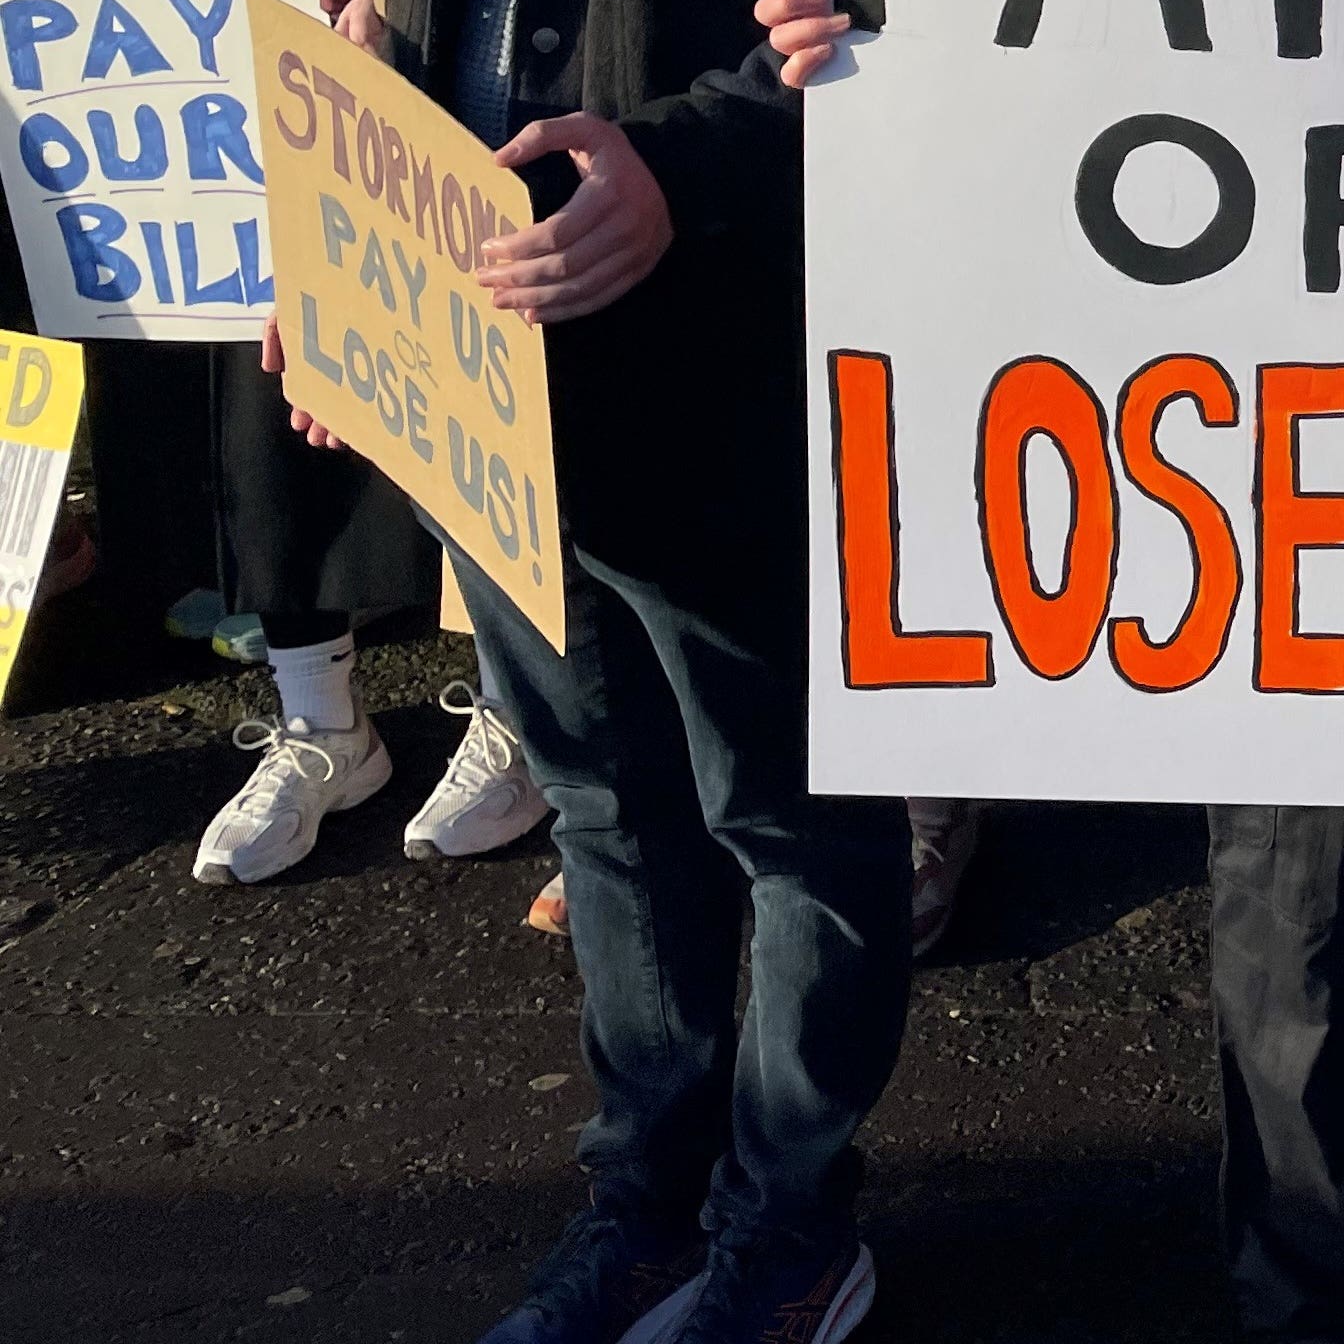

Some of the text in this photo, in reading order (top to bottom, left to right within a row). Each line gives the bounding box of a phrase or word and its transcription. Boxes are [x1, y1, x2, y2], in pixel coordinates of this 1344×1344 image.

[19, 93, 265, 192] OUR
[274, 48, 520, 276] STORMON
[56, 202, 275, 307] BILL
[319, 191, 516, 427] PAY US
[300, 290, 542, 587] LOSE US!
[394, 327, 440, 390] OR
